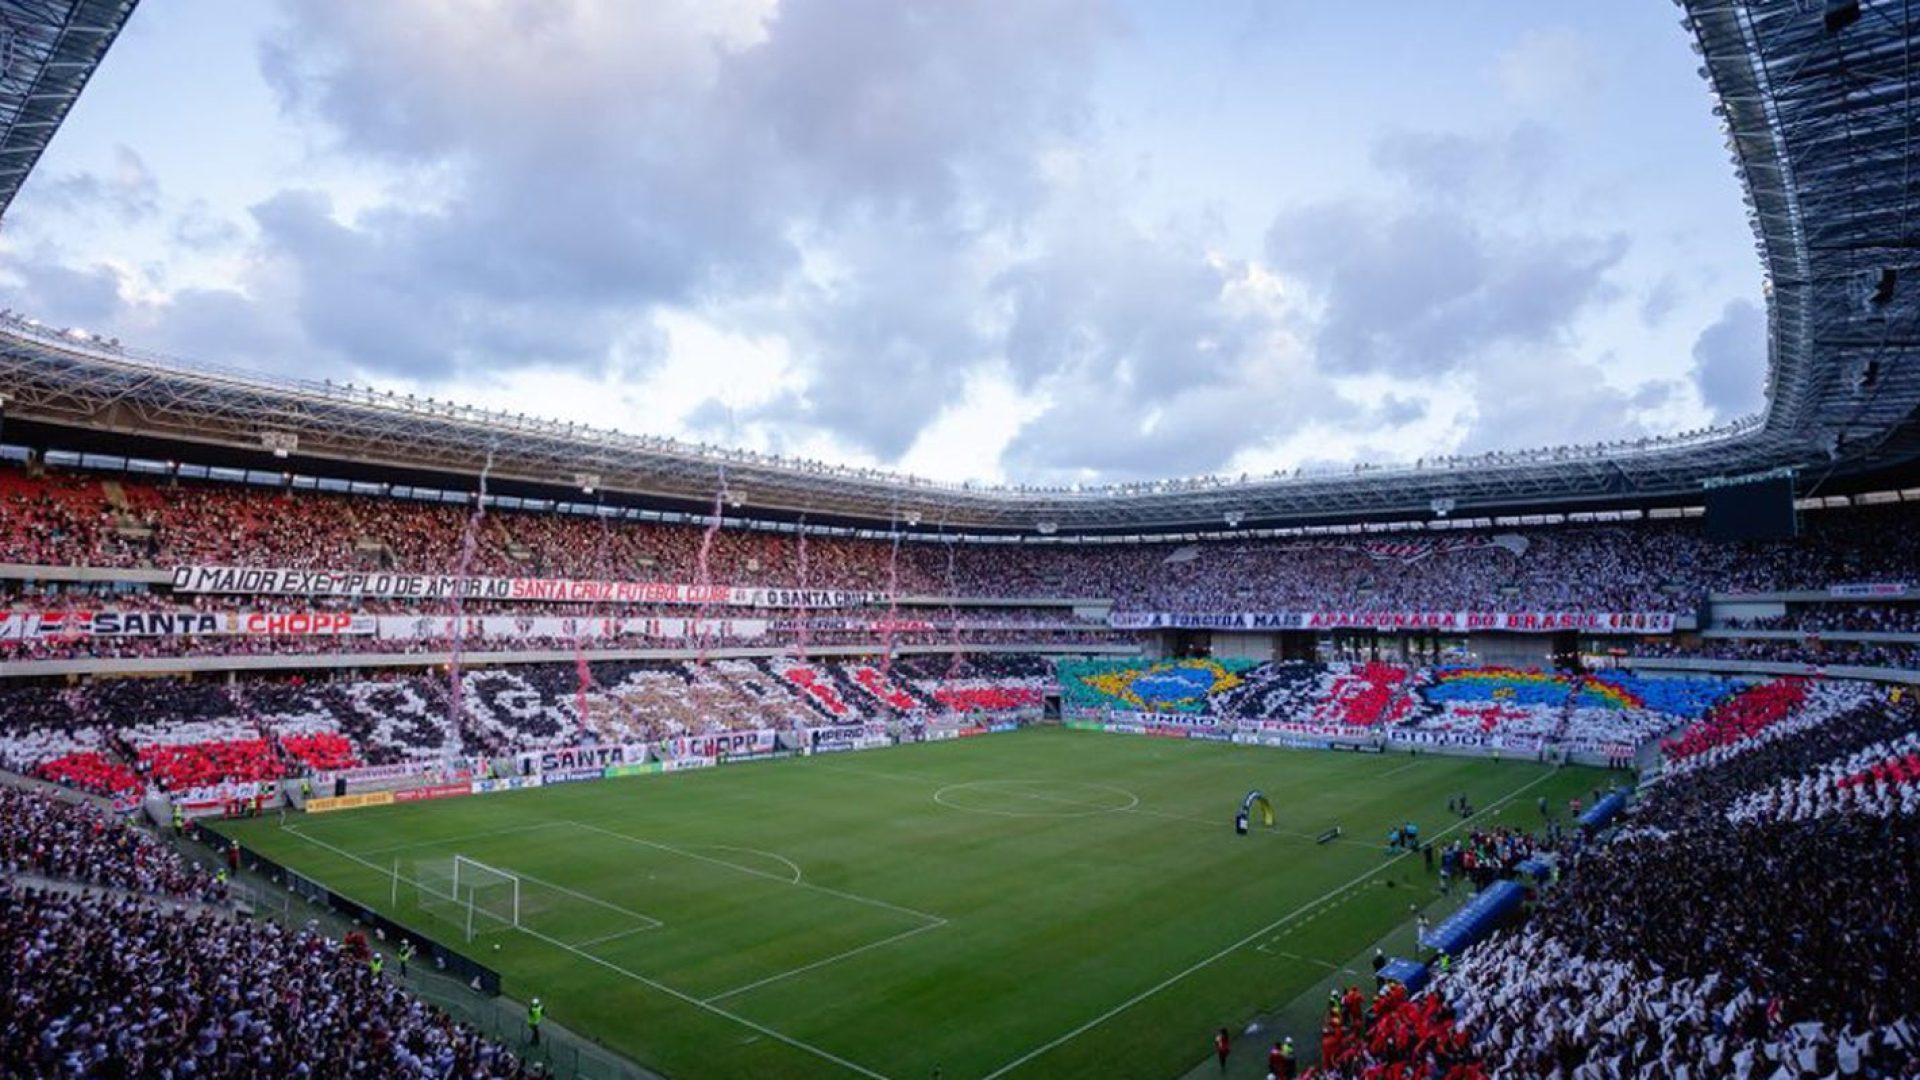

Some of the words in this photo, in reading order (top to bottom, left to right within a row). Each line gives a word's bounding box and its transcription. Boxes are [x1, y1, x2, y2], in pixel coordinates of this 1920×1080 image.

[173, 567, 192, 590] O
[197, 568, 278, 592] MAIOR
[281, 572, 391, 595] EXEMPLO
[394, 576, 423, 596] DE
[427, 578, 482, 598] AMOR
[485, 580, 510, 599] AO
[512, 578, 566, 601] SANTA
[570, 582, 613, 602] CRUZ
[616, 582, 680, 602] FUTEBOL
[767, 590, 777, 605] O
[780, 591, 831, 607] SANTA
[835, 592, 868, 609] CRUZ
[94, 613, 217, 634] SANTA
[247, 611, 352, 634] CHOPP
[1152, 614, 1163, 627] A
[1169, 613, 1245, 628] TORCIDA
[1253, 613, 1302, 628] MAIS
[1310, 612, 1456, 628] APAIXONADA
[1468, 612, 1496, 628] DO
[1507, 613, 1597, 630] BRASIL
[541, 747, 623, 771] SANTA
